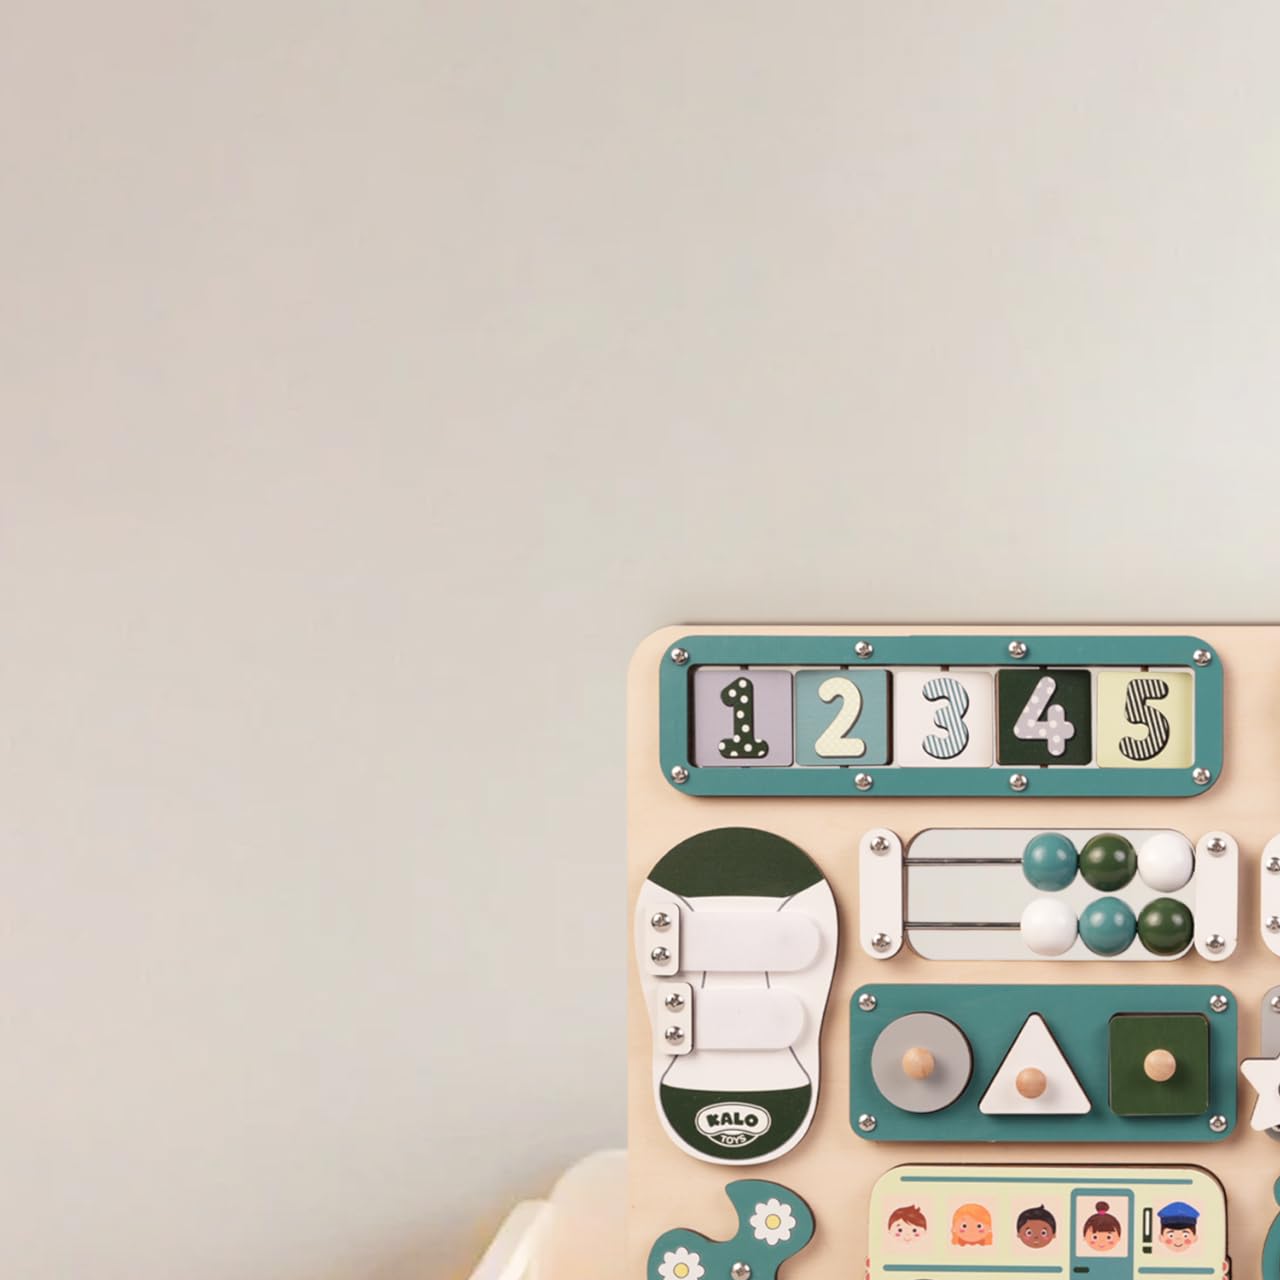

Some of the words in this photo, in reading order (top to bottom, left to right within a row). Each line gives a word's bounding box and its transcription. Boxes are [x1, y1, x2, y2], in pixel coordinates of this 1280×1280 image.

[718, 676, 769, 759] 1
[814, 677, 867, 758] 2
[922, 677, 970, 760] 3
[1012, 675, 1076, 757] 4
[1118, 677, 1171, 760] 5
[706, 1112, 759, 1128] KALO
[720, 1134, 747, 1145] TOYS
